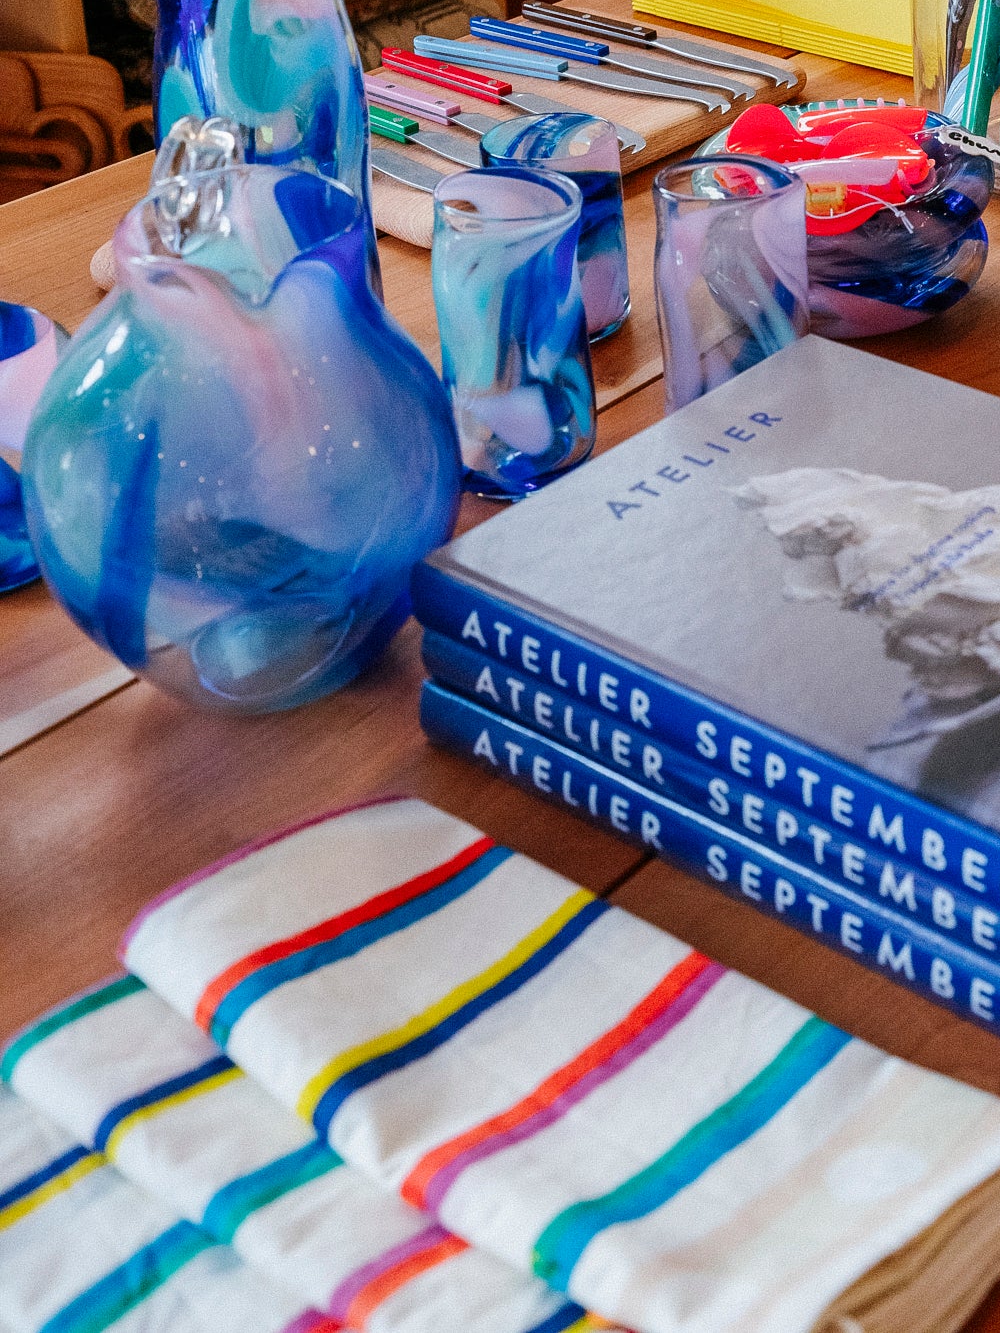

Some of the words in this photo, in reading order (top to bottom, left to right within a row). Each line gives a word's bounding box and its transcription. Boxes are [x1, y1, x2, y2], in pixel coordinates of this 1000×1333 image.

[606, 412, 783, 519] ATELIER
[462, 610, 652, 729] ATELIER
[475, 666, 665, 785] ATELIER
[473, 728, 664, 851] ATELIER
